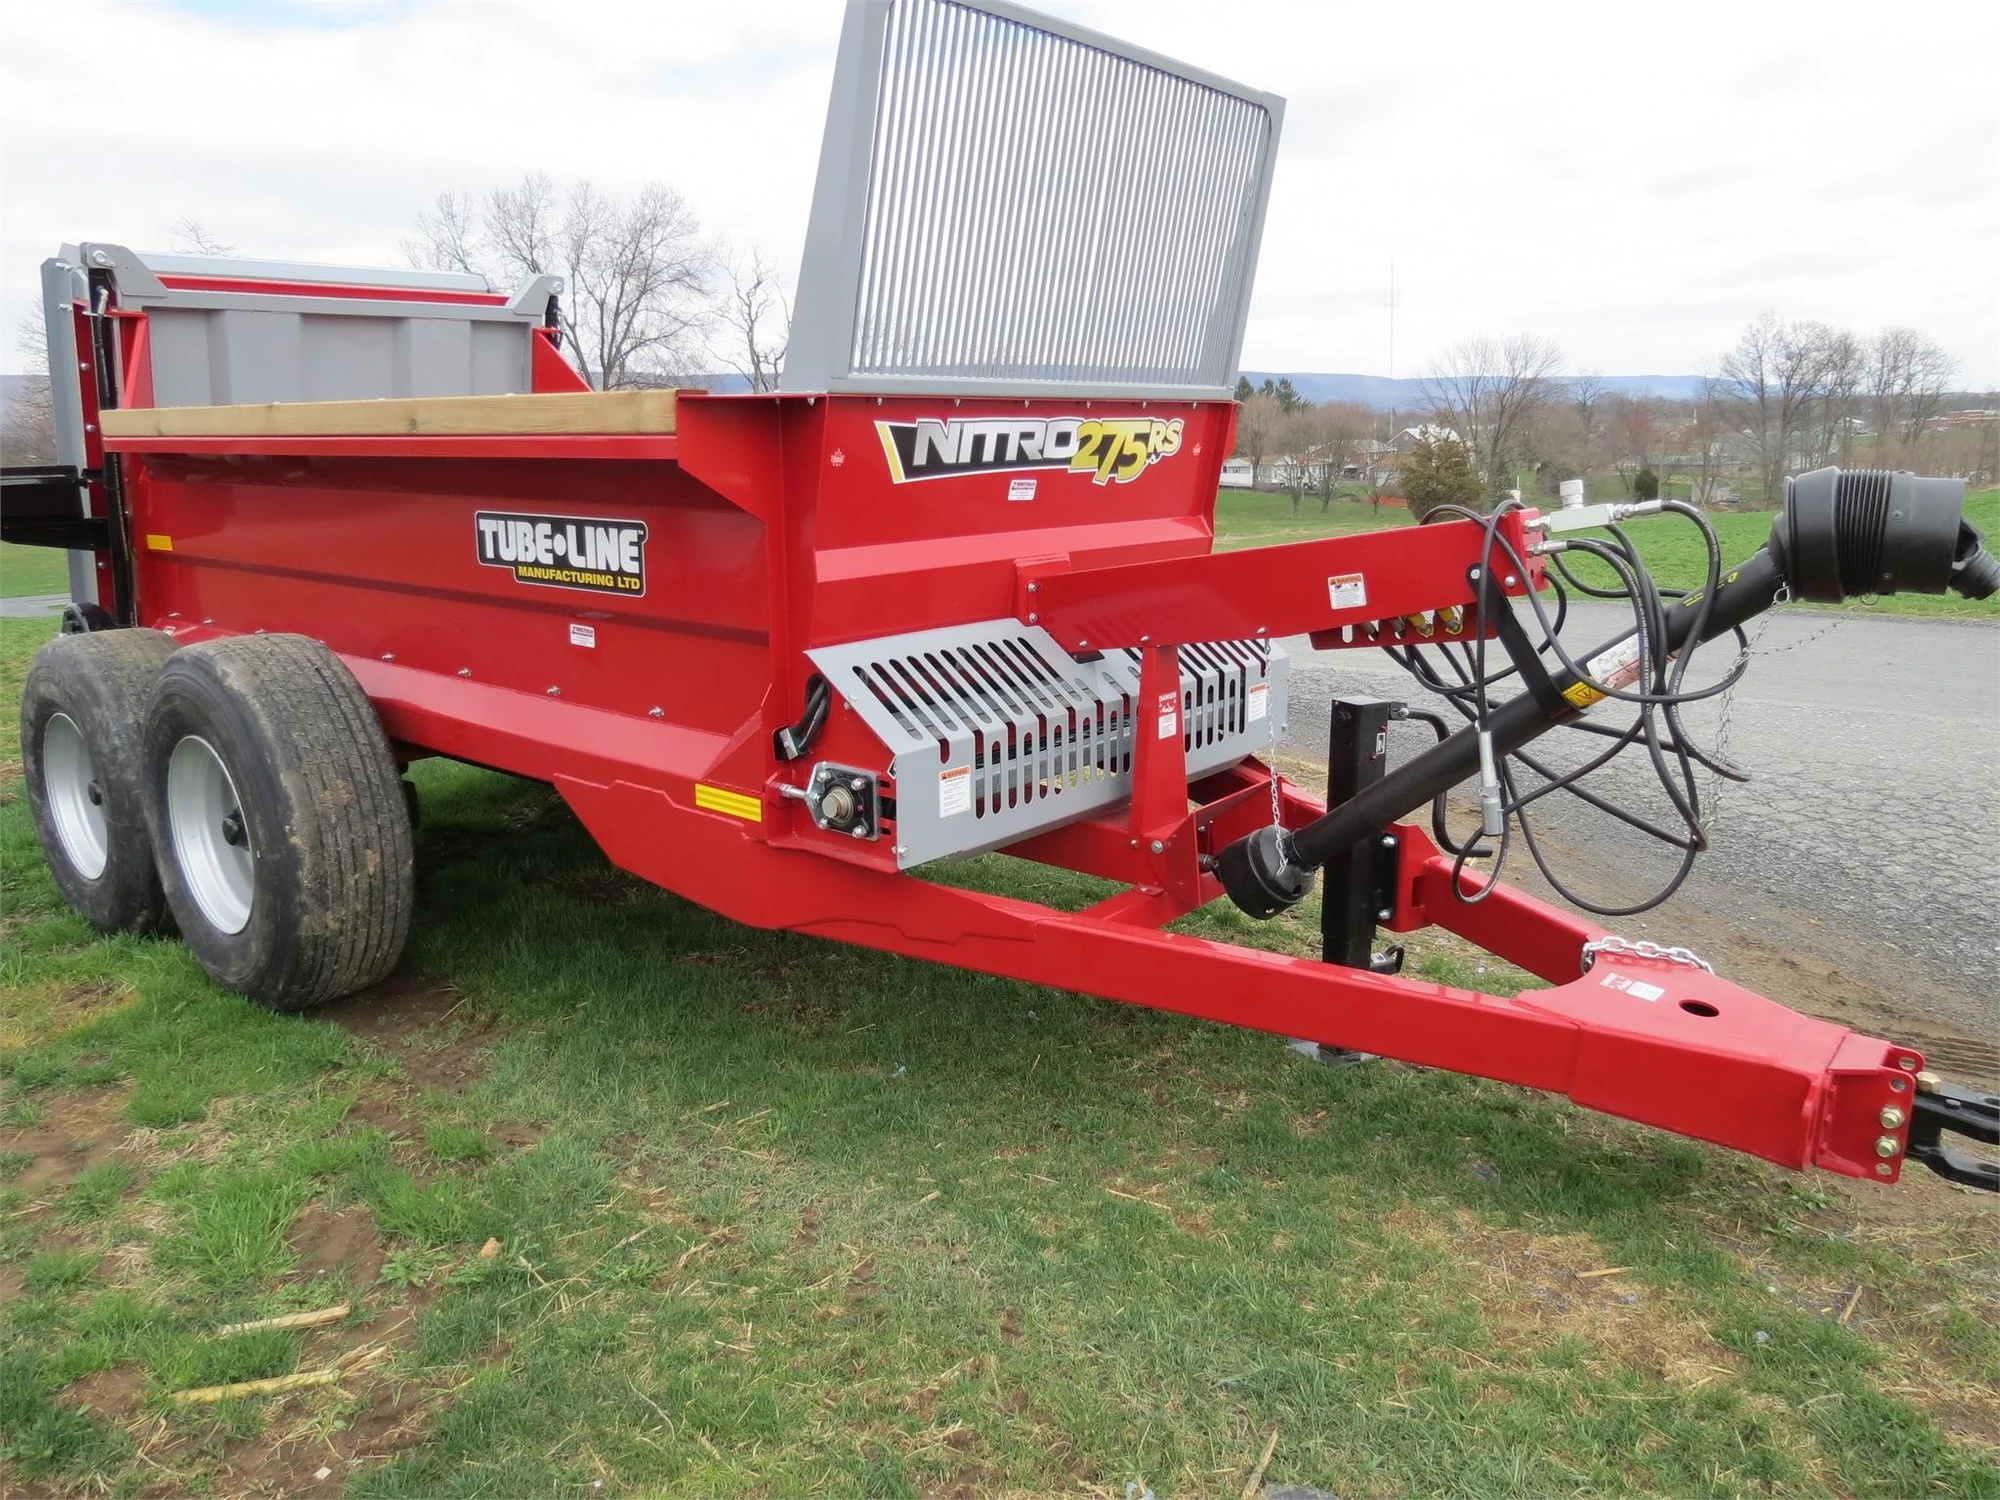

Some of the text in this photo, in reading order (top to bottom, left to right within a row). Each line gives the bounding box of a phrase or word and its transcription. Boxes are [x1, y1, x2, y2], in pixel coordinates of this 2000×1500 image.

[912, 420, 1080, 466] NITRO
[518, 566, 641, 590] MANUFACTURING LTD
